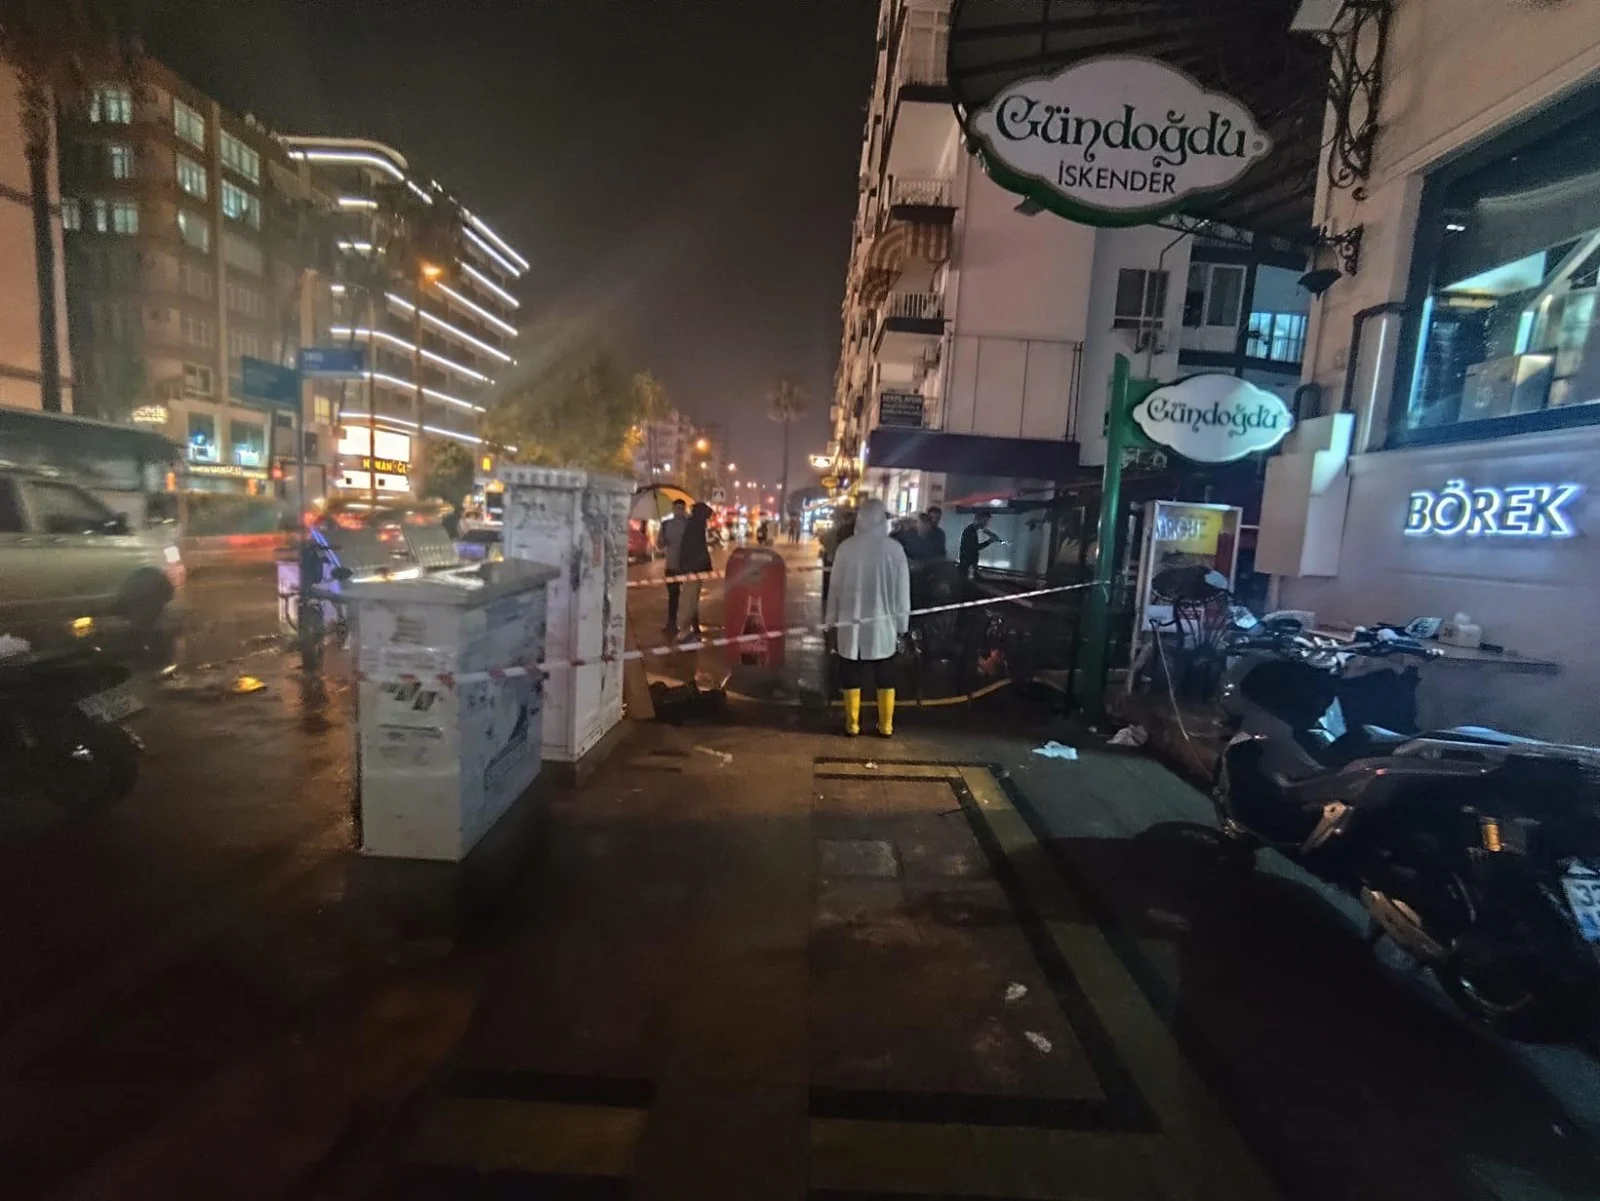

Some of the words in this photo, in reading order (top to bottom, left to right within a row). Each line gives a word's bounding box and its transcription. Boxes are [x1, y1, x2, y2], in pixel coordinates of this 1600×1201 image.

[995, 95, 1246, 168] Gündoğdu
[1057, 160, 1176, 195] İSKENDER
[1147, 397, 1278, 438] Gündoğdu
[1404, 479, 1583, 539] BÖREK
